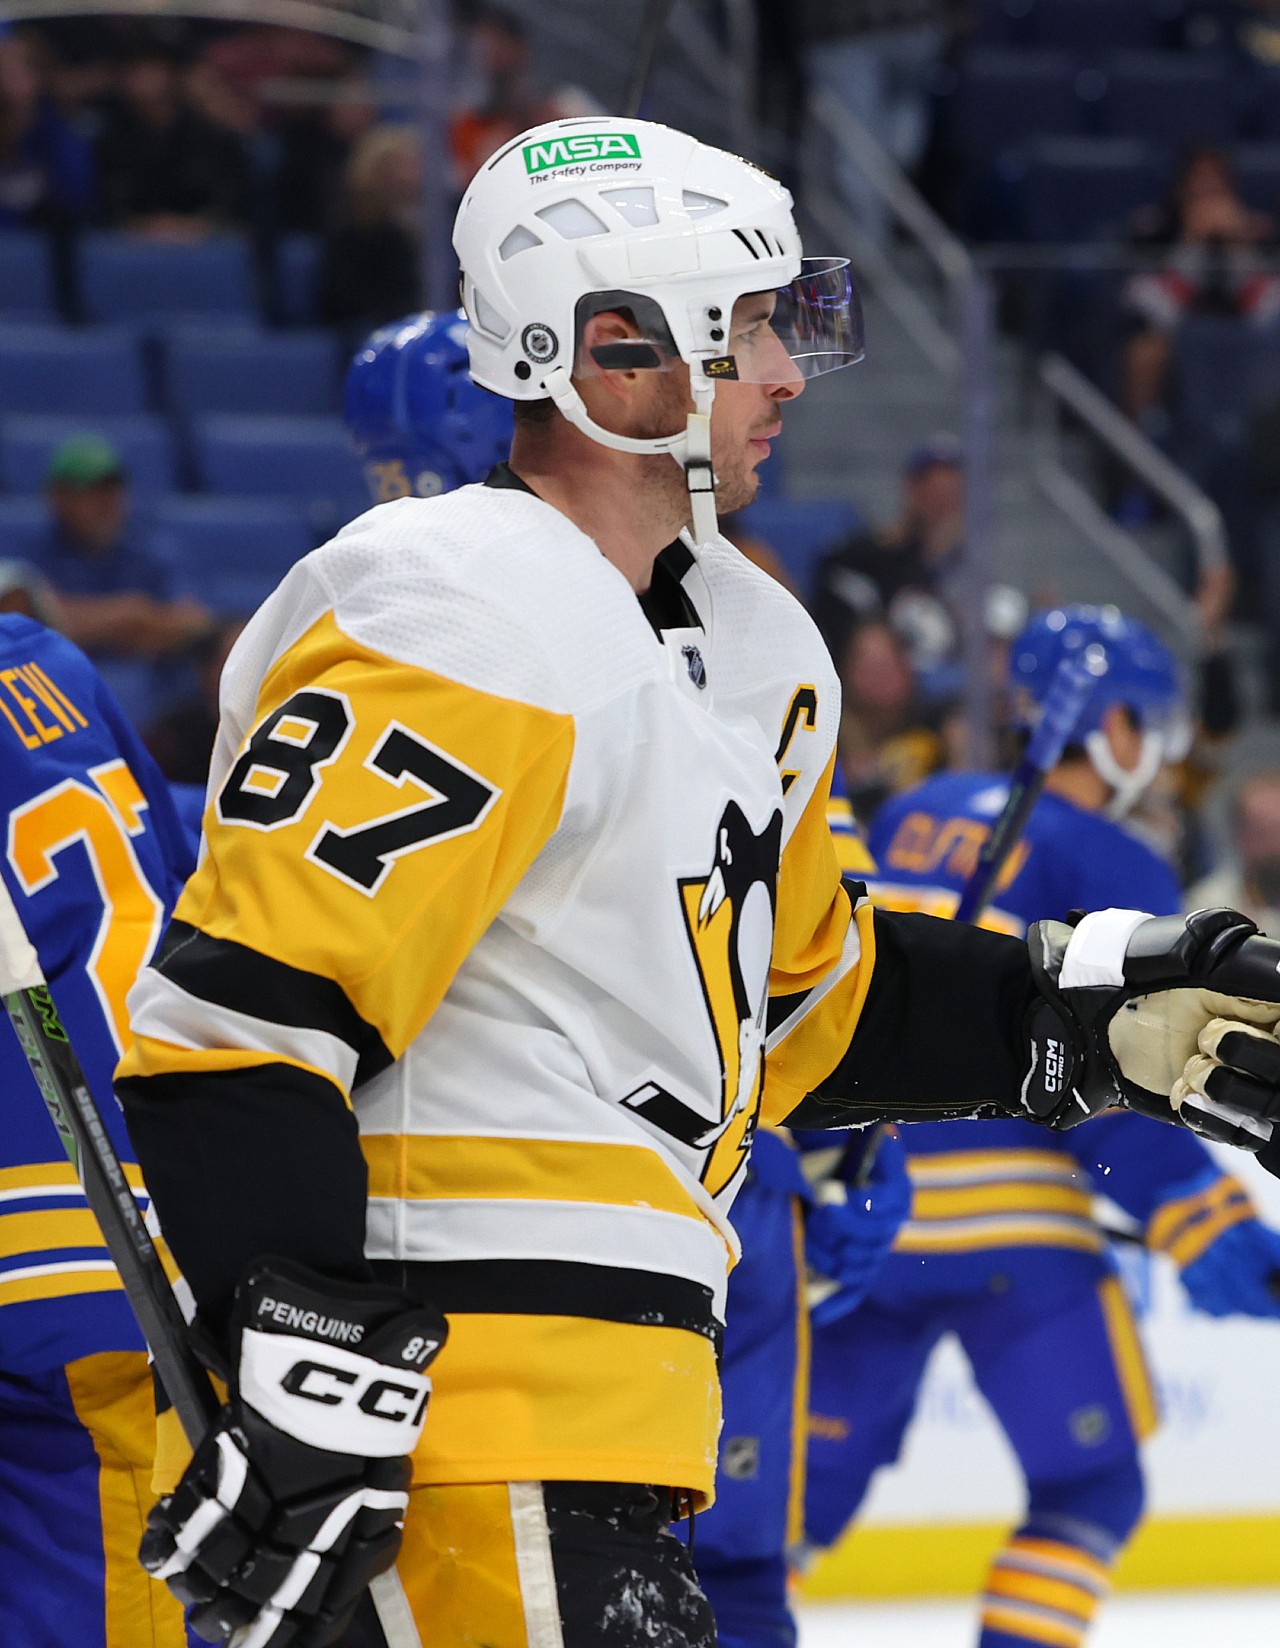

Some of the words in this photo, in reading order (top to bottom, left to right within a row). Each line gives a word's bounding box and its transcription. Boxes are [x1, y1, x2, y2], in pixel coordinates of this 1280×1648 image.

[529, 136, 636, 170] MSA
[529, 173, 549, 185] The
[551, 166, 587, 179] Safety
[589, 161, 642, 176] Company
[214, 686, 503, 899] 87
[1045, 1038, 1058, 1093] CCM
[257, 1297, 365, 1344] PENGUINS
[401, 1336, 440, 1365] 87
